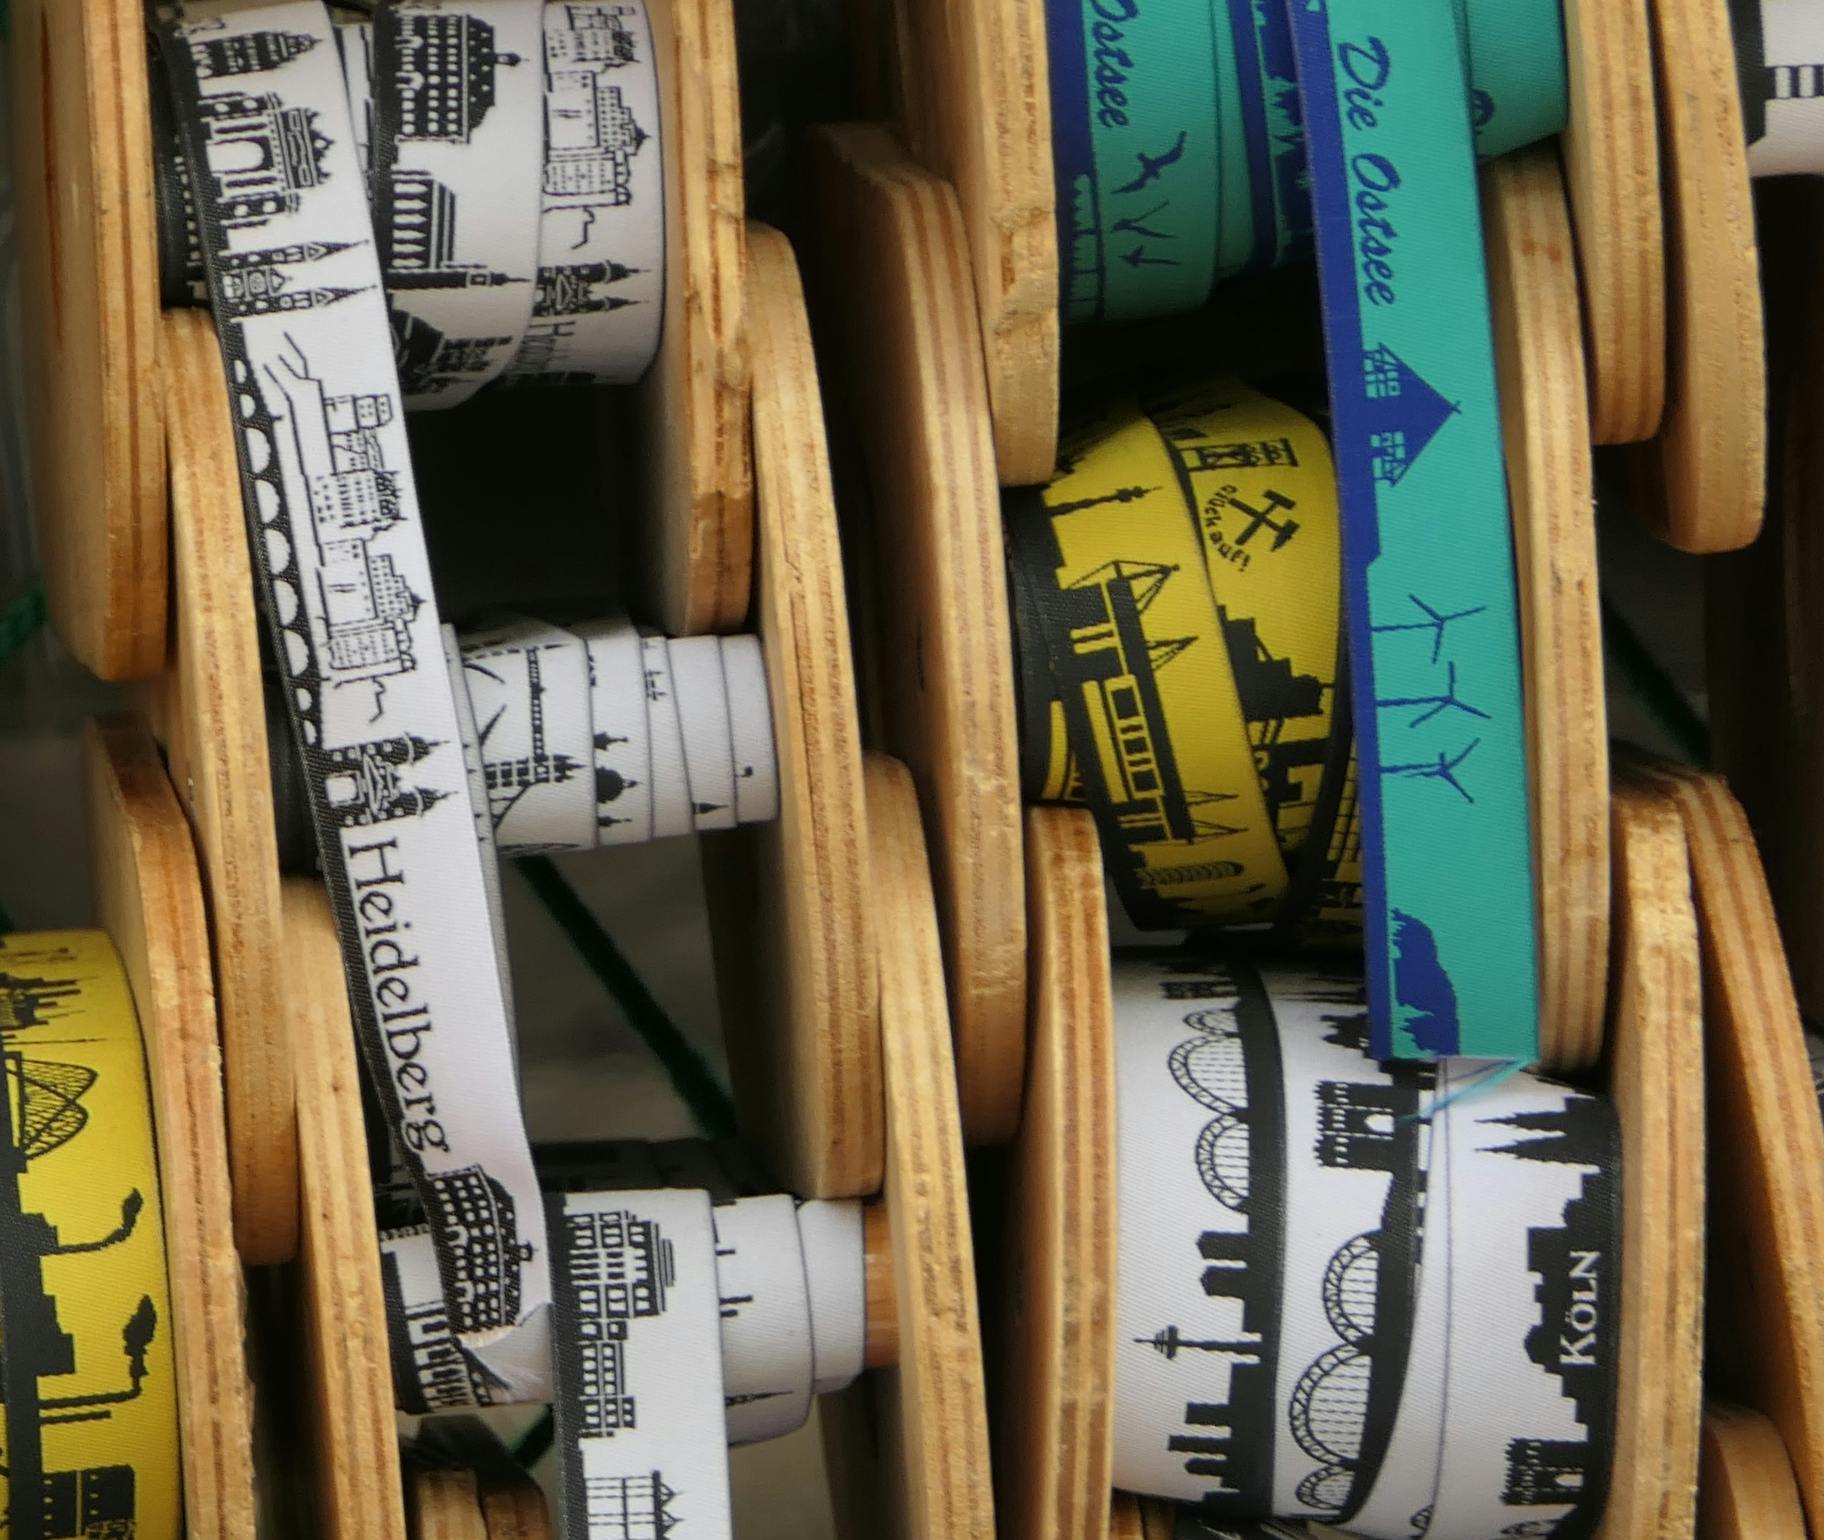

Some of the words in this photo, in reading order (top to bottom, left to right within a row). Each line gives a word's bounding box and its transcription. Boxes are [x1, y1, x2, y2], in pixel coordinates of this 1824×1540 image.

[1336, 36, 1390, 131] Die
[1349, 152, 1403, 307] Ostsee
[348, 836, 451, 1170] Heidelberg
[1558, 1249, 1601, 1367] KÖLN
